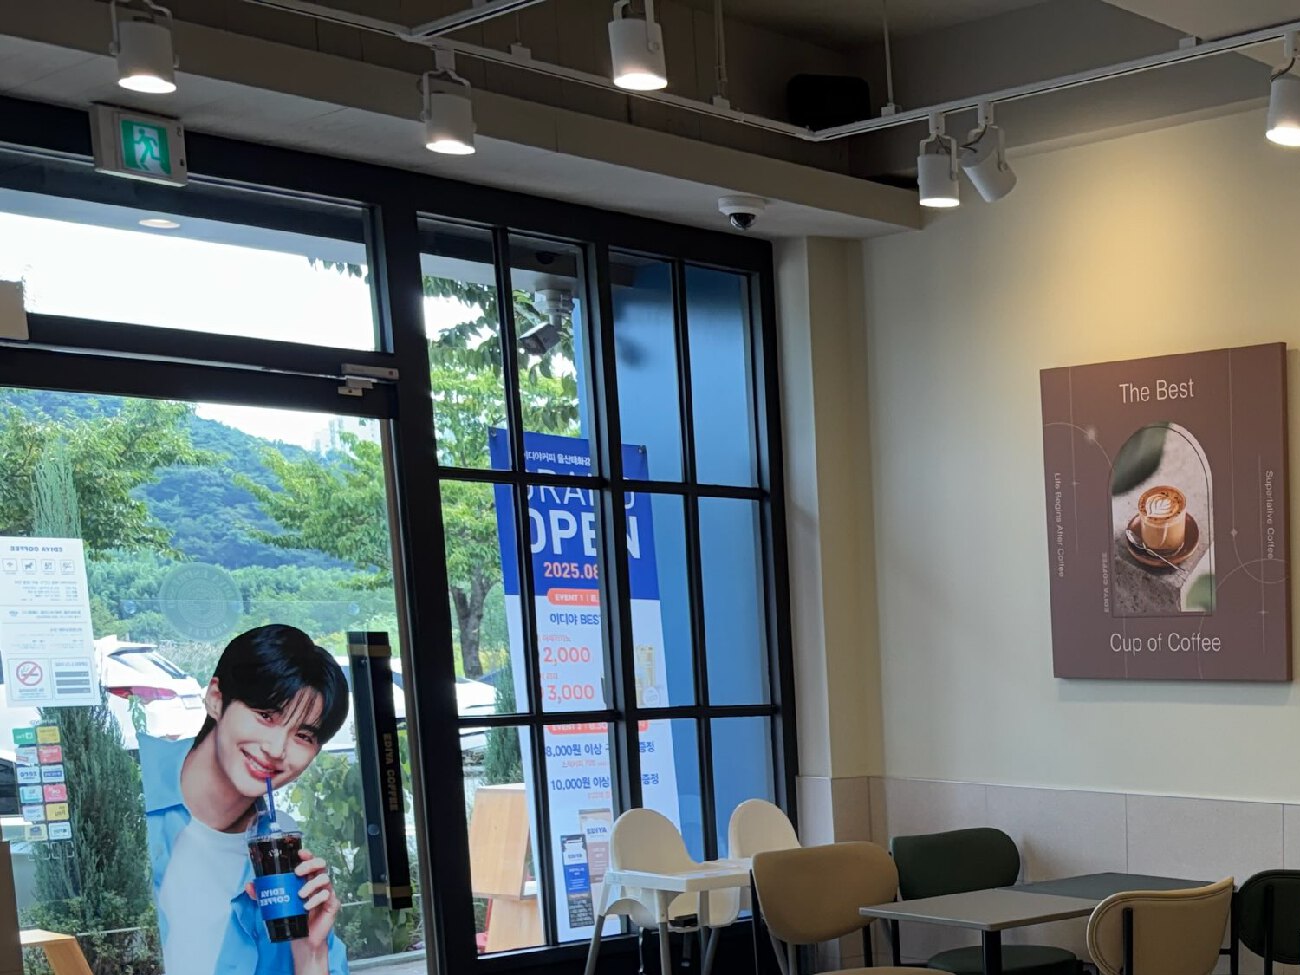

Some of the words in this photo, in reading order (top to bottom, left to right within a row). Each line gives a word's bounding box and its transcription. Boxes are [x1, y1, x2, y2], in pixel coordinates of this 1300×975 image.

[1119, 382, 1151, 404] The
[1156, 378, 1194, 401] Best
[1267, 527, 1275, 560] Coffee
[550, 613, 577, 625] 이디야
[580, 613, 600, 625] BES
[1110, 632, 1142, 656] Cup
[1147, 632, 1162, 652] of
[1167, 632, 1221, 652] Coffee
[543, 646, 590, 666] 2,000
[547, 684, 595, 704] 3,000
[584, 743, 602, 756] 이상
